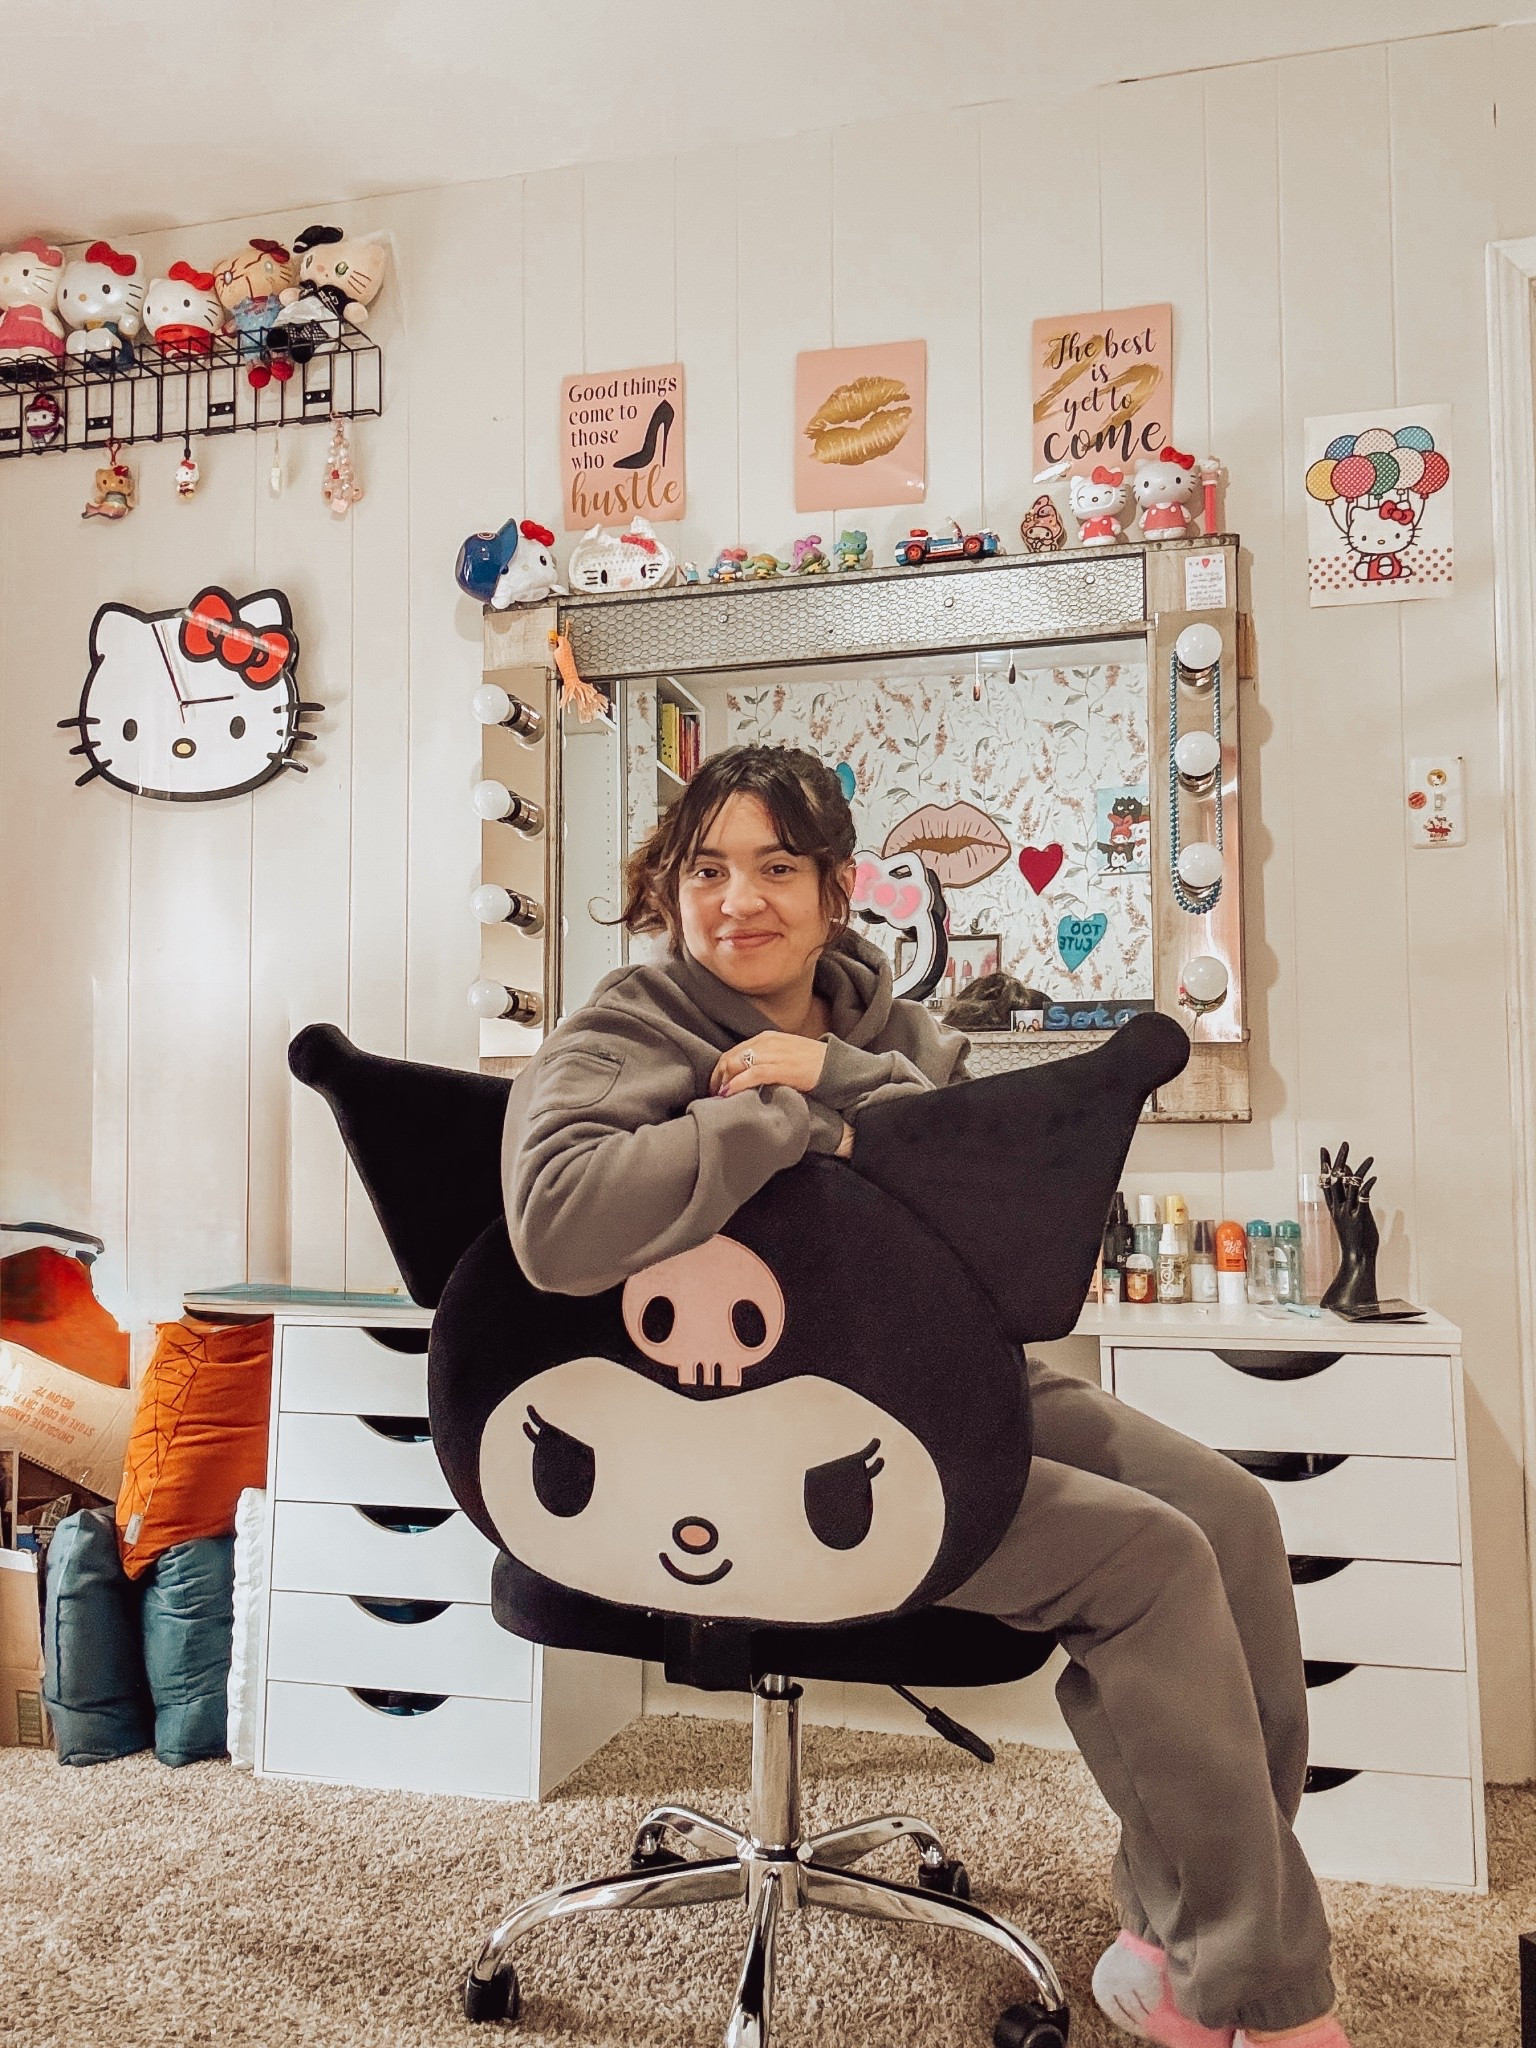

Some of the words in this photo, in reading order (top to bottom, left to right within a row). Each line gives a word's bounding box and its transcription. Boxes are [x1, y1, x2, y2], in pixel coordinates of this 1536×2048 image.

[1049, 332, 1095, 370] The
[1105, 328, 1157, 359] best
[1091, 363, 1110, 383] is
[569, 381, 618, 403] Good
[623, 377, 677, 397] things
[569, 406, 614, 425] come
[620, 404, 638, 420] to
[1064, 387, 1104, 432] yet
[1110, 386, 1133, 411] to
[571, 429, 619, 448] those
[1043, 419, 1167, 464] come
[571, 452, 605, 470] who
[571, 464, 681, 518] hustle
[1160, 1258, 1175, 1296] SOL
[46, 1391, 75, 1410] BELOW
[38, 1404, 60, 1420] COOL
[58, 1414, 69, 1425] IN
[30, 1417, 75, 1445] CHOCOLATE
[68, 1418, 96, 1437] STORE
